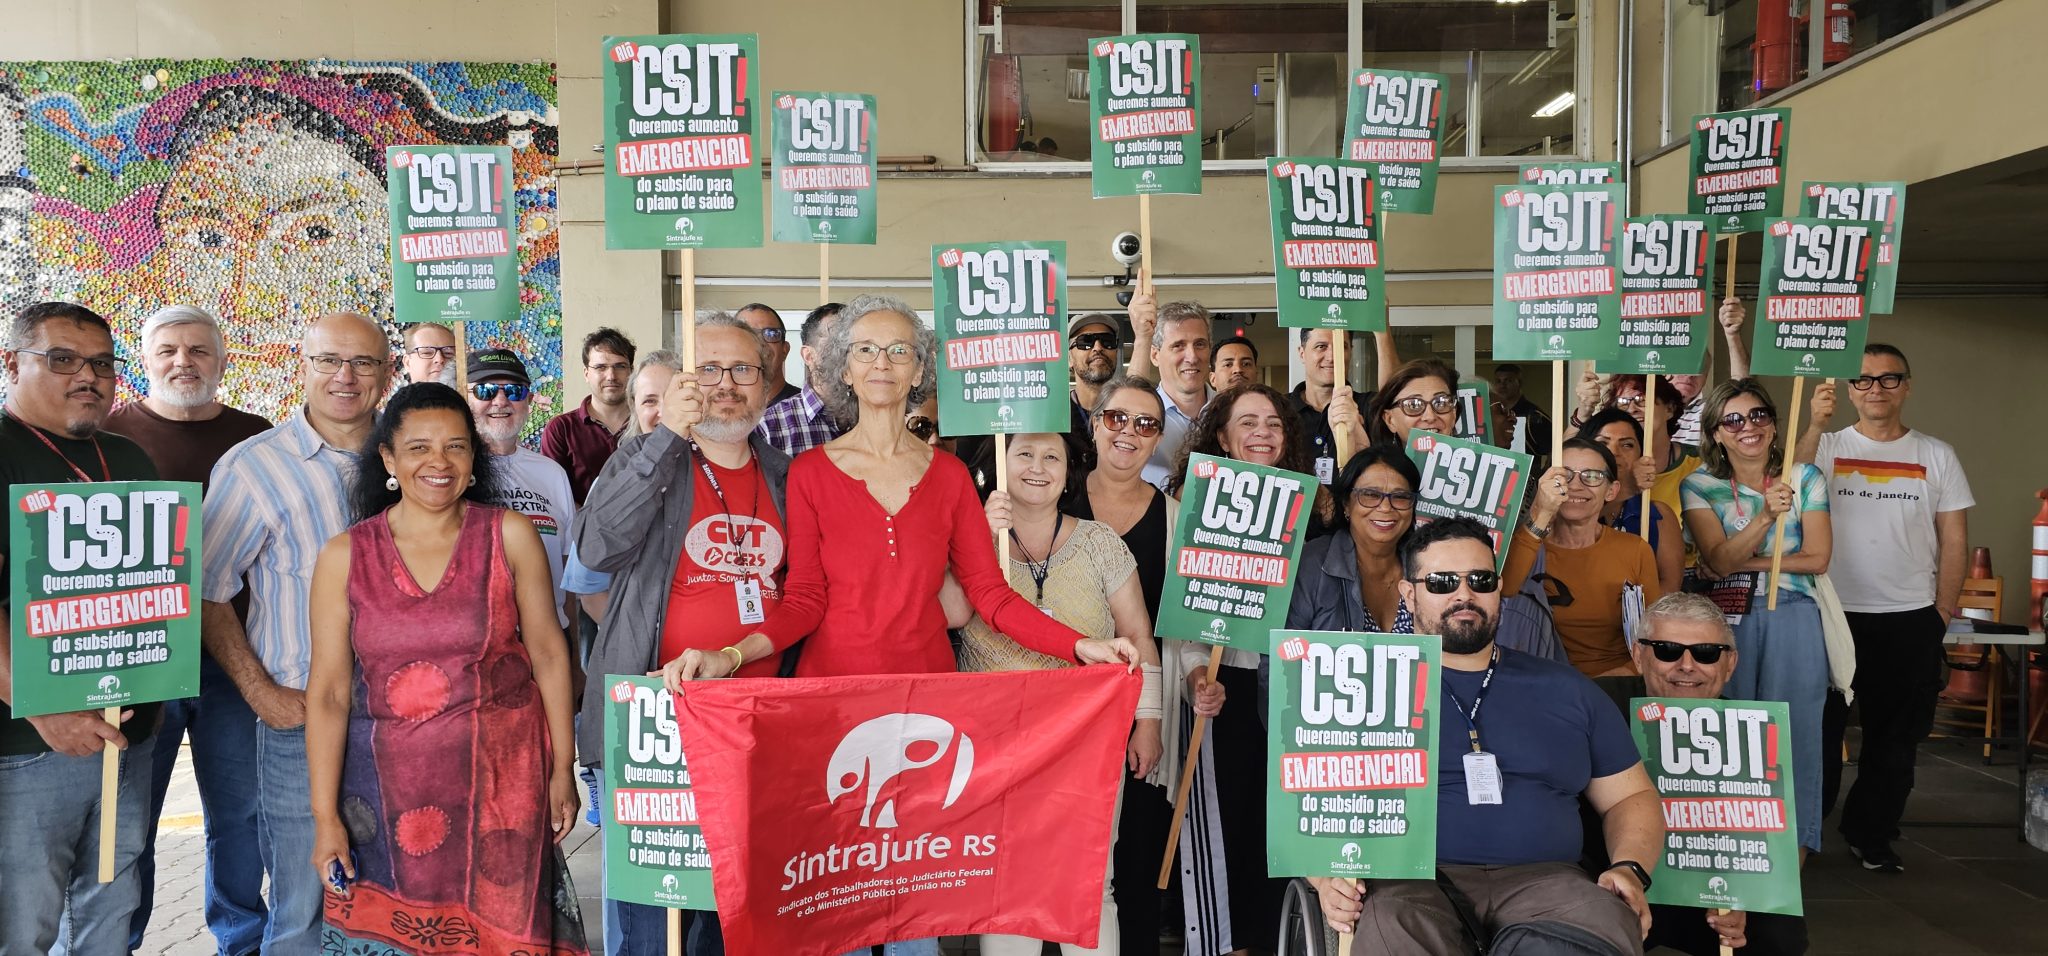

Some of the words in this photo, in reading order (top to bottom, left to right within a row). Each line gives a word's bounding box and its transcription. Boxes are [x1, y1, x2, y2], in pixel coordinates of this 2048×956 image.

[1110, 37, 1192, 95] CSJT!
[633, 42, 747, 115] CSJT!
[1108, 98, 1148, 111] Queremos
[1151, 95, 1186, 107] aumento
[1367, 76, 1443, 128] CSJT!
[629, 119, 685, 136] Queremos
[689, 117, 738, 132] aumento
[792, 98, 870, 152] CSJT!
[1101, 110, 1194, 139] EMERGENCIAL
[1362, 124, 1397, 136] Queremos
[1399, 128, 1430, 138] aumento
[1708, 114, 1783, 160] CSJT!
[619, 137, 748, 173] EMERGENCIAL
[789, 150, 826, 163] Queremos
[829, 153, 862, 164] aumento
[1353, 141, 1433, 159] EMERGENCIAL
[1705, 162, 1740, 173] Queremos
[1742, 157, 1772, 168] aumento
[407, 153, 502, 213] CSJT!
[655, 174, 703, 192] subsídio
[707, 179, 732, 192] para
[782, 167, 868, 188] EMERGENCIAL
[1697, 168, 1777, 194] EMERGENCIAL
[647, 196, 678, 213] plano
[699, 193, 734, 209] saúde
[1294, 163, 1373, 227] CSJT!
[408, 215, 452, 230] Queremos
[456, 214, 497, 226] aumento
[1292, 222, 1332, 236] Queremos
[1335, 226, 1368, 239] aumento
[1519, 191, 1616, 251] CSJT!
[399, 230, 506, 260] EMERGENCIAL
[1286, 243, 1377, 265] EMERGENCIAL
[1623, 220, 1710, 276] CSJT!
[1785, 224, 1872, 282] CSJT!
[430, 261, 469, 275] subsídio
[472, 264, 493, 276] para
[1515, 254, 1561, 268] Queremos
[1564, 252, 1604, 265] aumento
[425, 278, 449, 292] plano
[466, 276, 495, 289] saúde
[958, 248, 1057, 314] CSJT!
[1505, 269, 1611, 299] EMERGENCIAL
[1622, 276, 1660, 289] ueremos
[1662, 277, 1698, 288] aumento
[1779, 279, 1820, 292] Queremos
[1822, 282, 1857, 293] aumento
[1534, 300, 1574, 314] subsídio
[1577, 303, 1597, 314] para
[1621, 292, 1704, 317] MERGENCIAL
[1769, 297, 1861, 319] EMERGENCIAL
[956, 318, 1004, 334] Queremos
[1008, 316, 1050, 329] aumento
[1527, 317, 1552, 331] plano
[1570, 315, 1598, 328] saúde
[948, 333, 1060, 367] EMERGENCIAL
[980, 367, 1021, 383] subsídio
[1025, 370, 1045, 383] para
[974, 386, 1000, 402] plano
[1018, 383, 1047, 397] saúde
[1420, 442, 1520, 517] CSJT!
[503, 488, 533, 499] NÃO
[533, 492, 552, 506] TEM
[1203, 467, 1305, 543] CSJT!
[1876, 492, 1919, 500] janeiro
[512, 502, 550, 514] EXTRA
[49, 487, 192, 570] CSJT!
[707, 521, 766, 547] CUT
[1193, 528, 1240, 548] Queremos
[1242, 539, 1282, 555] aumento
[1179, 550, 1284, 583] EMERGENCIAL
[44, 574, 113, 594] Queremos
[117, 567, 175, 586] aumento
[684, 573, 716, 585] Juntos
[1202, 582, 1242, 599] subsídio
[1244, 590, 1265, 603] para
[31, 586, 188, 634] EMERGENCIAL
[1192, 596, 1218, 611] plano
[1234, 602, 1262, 618] saúde
[75, 631, 132, 651] subsídio
[137, 630, 165, 646] para
[65, 655, 102, 673] plano
[127, 646, 167, 664] saúde
[1302, 643, 1429, 729] CSJT!
[1296, 727, 1357, 747] Queremos
[1361, 729, 1414, 747] aumento
[1660, 707, 1777, 778] CSJT!
[625, 764, 674, 783] Queremos
[1284, 753, 1424, 789] EMERGENCIAL
[1658, 776, 1715, 793] Queremos
[1719, 781, 1771, 796] aumento
[616, 792, 698, 822] EMERGEN
[1321, 794, 1374, 813] subsídio
[1378, 799, 1404, 814] para
[1662, 800, 1781, 828] MERGENCIAL
[1312, 816, 1346, 835] plano
[1369, 815, 1405, 834] saúde
[646, 828, 688, 847] subsídio
[693, 834, 706, 849] pa
[1686, 834, 1736, 851] subsídio
[1741, 840, 1766, 854] para
[639, 848, 665, 865] plano
[780, 833, 952, 890] Sintrajufe
[963, 835, 996, 856] RS
[1679, 852, 1710, 869] plano
[1733, 854, 1769, 872] saúde
[777, 896, 812, 916] Sindicato
[815, 889, 829, 900] dos
[831, 878, 893, 896] Trabalhadores
[896, 875, 908, 884] do
[910, 870, 956, 883] Judiciário
[958, 868, 993, 877] Federal
[805, 905, 815, 915] do
[817, 894, 860, 912] Ministério
[863, 887, 895, 899] Público
[898, 886, 908, 894] da
[912, 882, 937, 892] União
